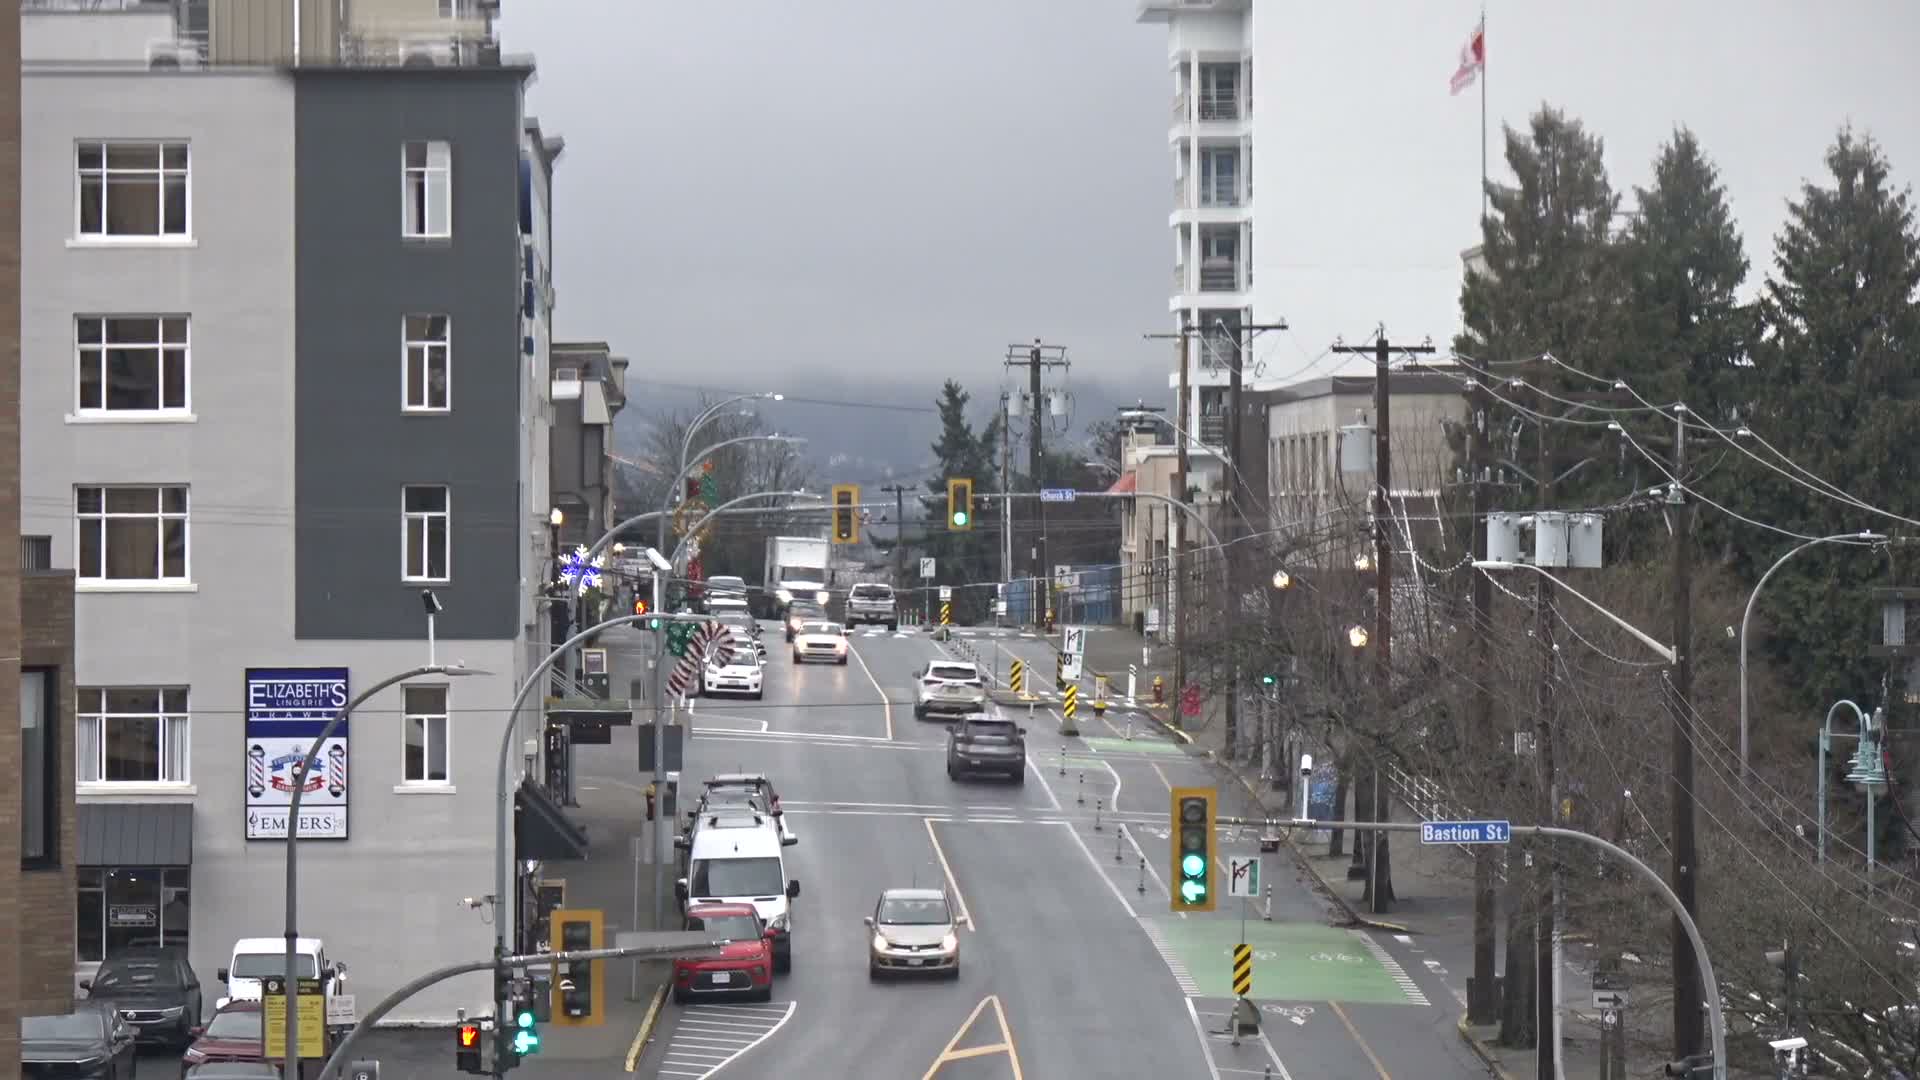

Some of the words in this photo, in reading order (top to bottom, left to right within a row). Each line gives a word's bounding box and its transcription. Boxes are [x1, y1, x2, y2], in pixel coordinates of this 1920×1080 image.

[249, 683, 347, 707] ELIZABETH'S
[251, 711, 329, 719] DRAWE
[261, 816, 332, 830] EMERS
[1423, 824, 1480, 841] Bastion
[1486, 823, 1507, 840] St.
